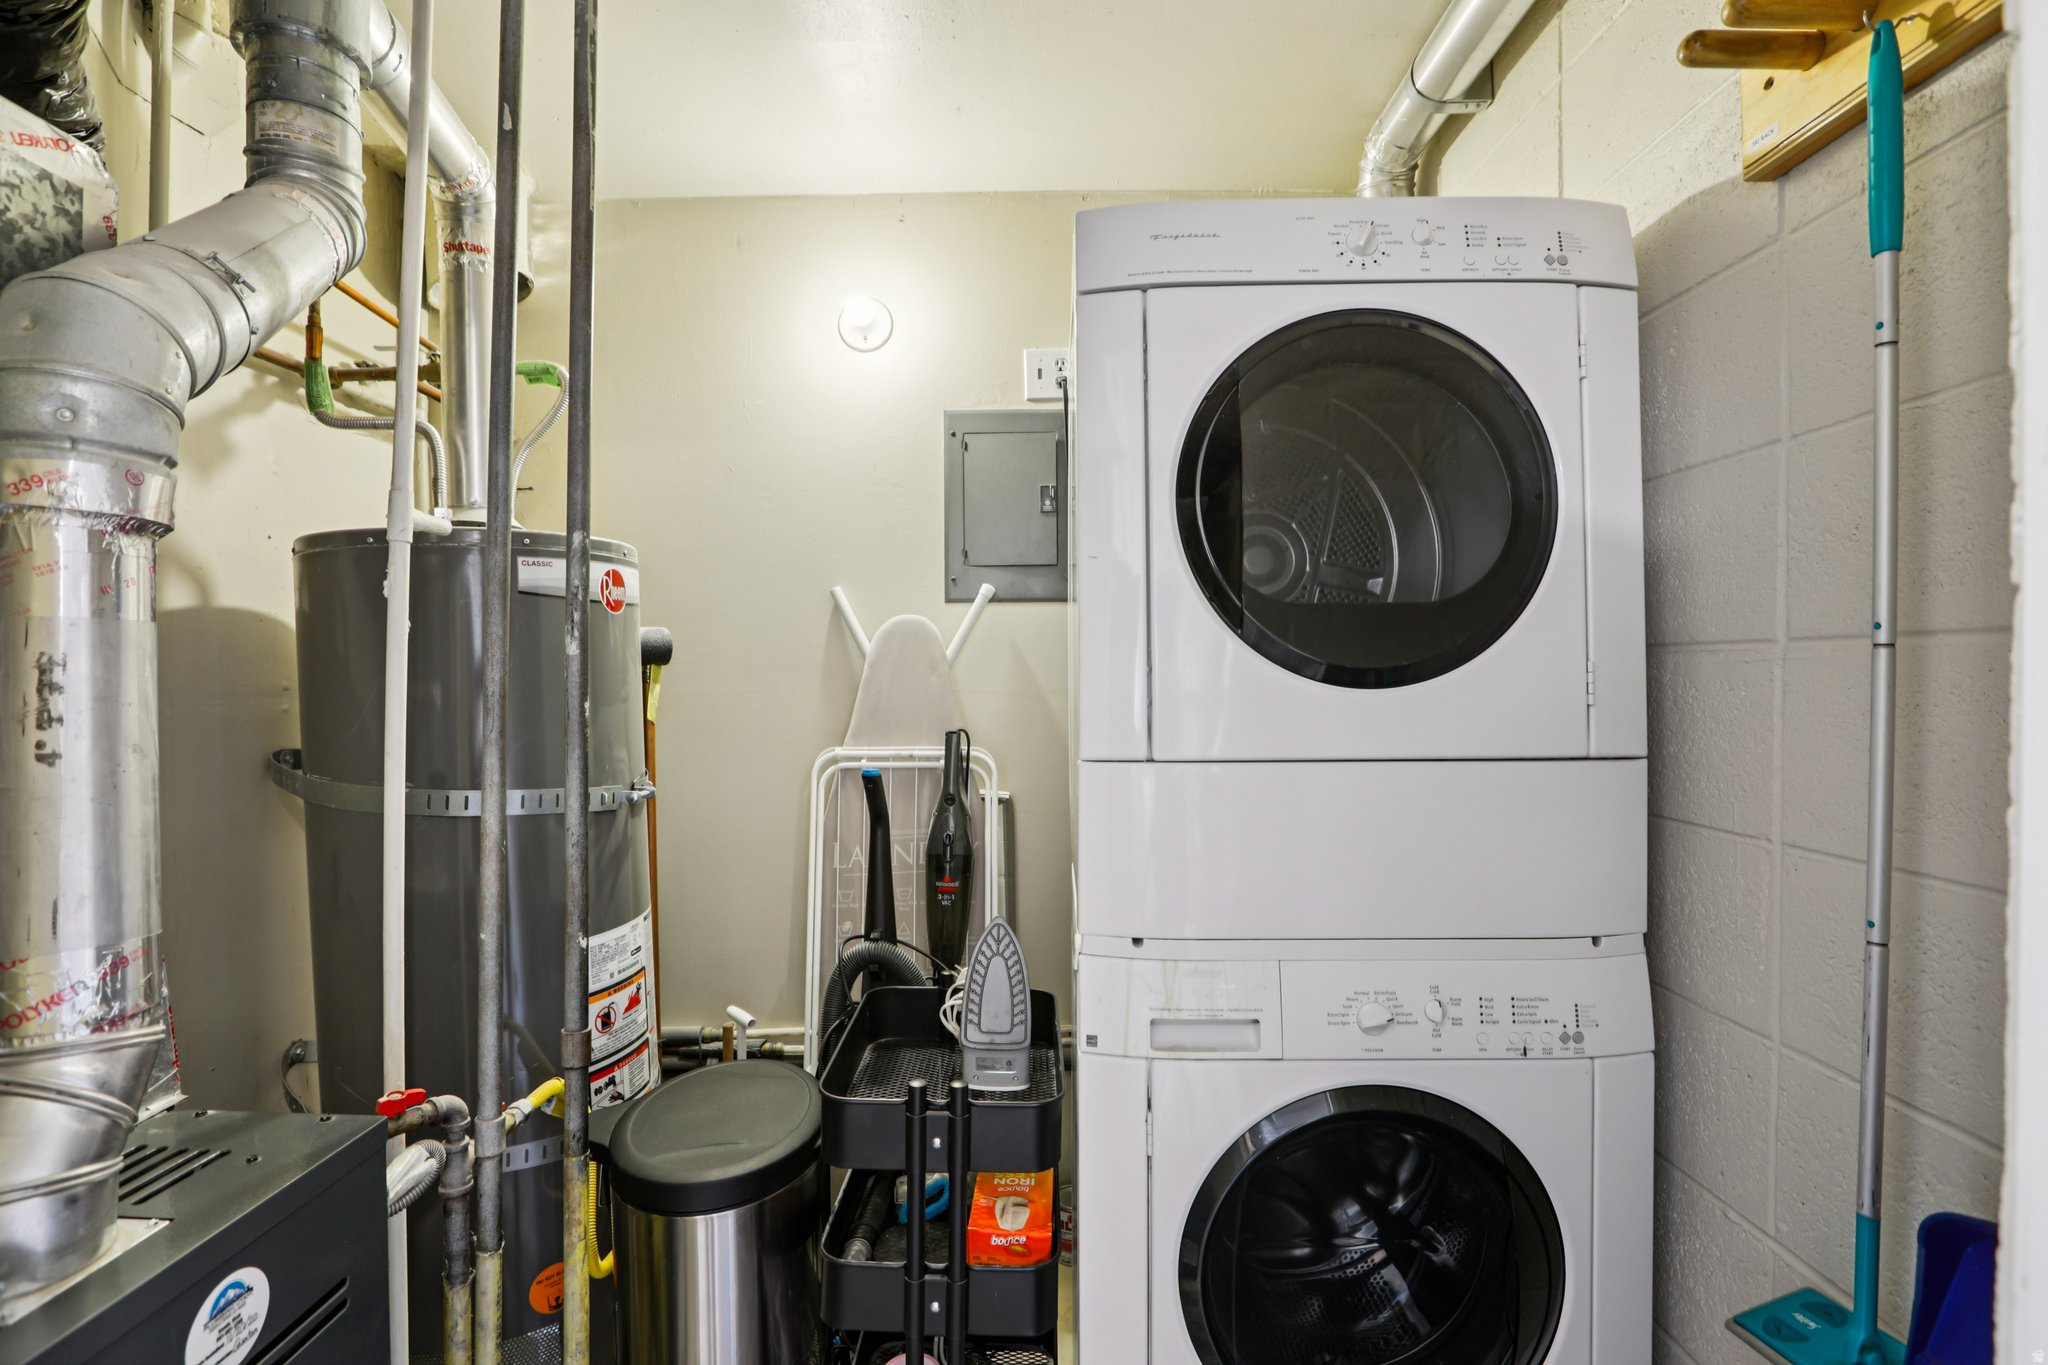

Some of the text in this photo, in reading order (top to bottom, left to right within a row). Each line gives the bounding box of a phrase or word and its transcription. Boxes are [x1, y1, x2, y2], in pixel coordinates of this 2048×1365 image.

[7, 474, 43, 497] 339
[521, 560, 553, 568] CLASSIC
[994, 1177, 1036, 1186] IRON
[991, 1234, 1027, 1247] bounce
